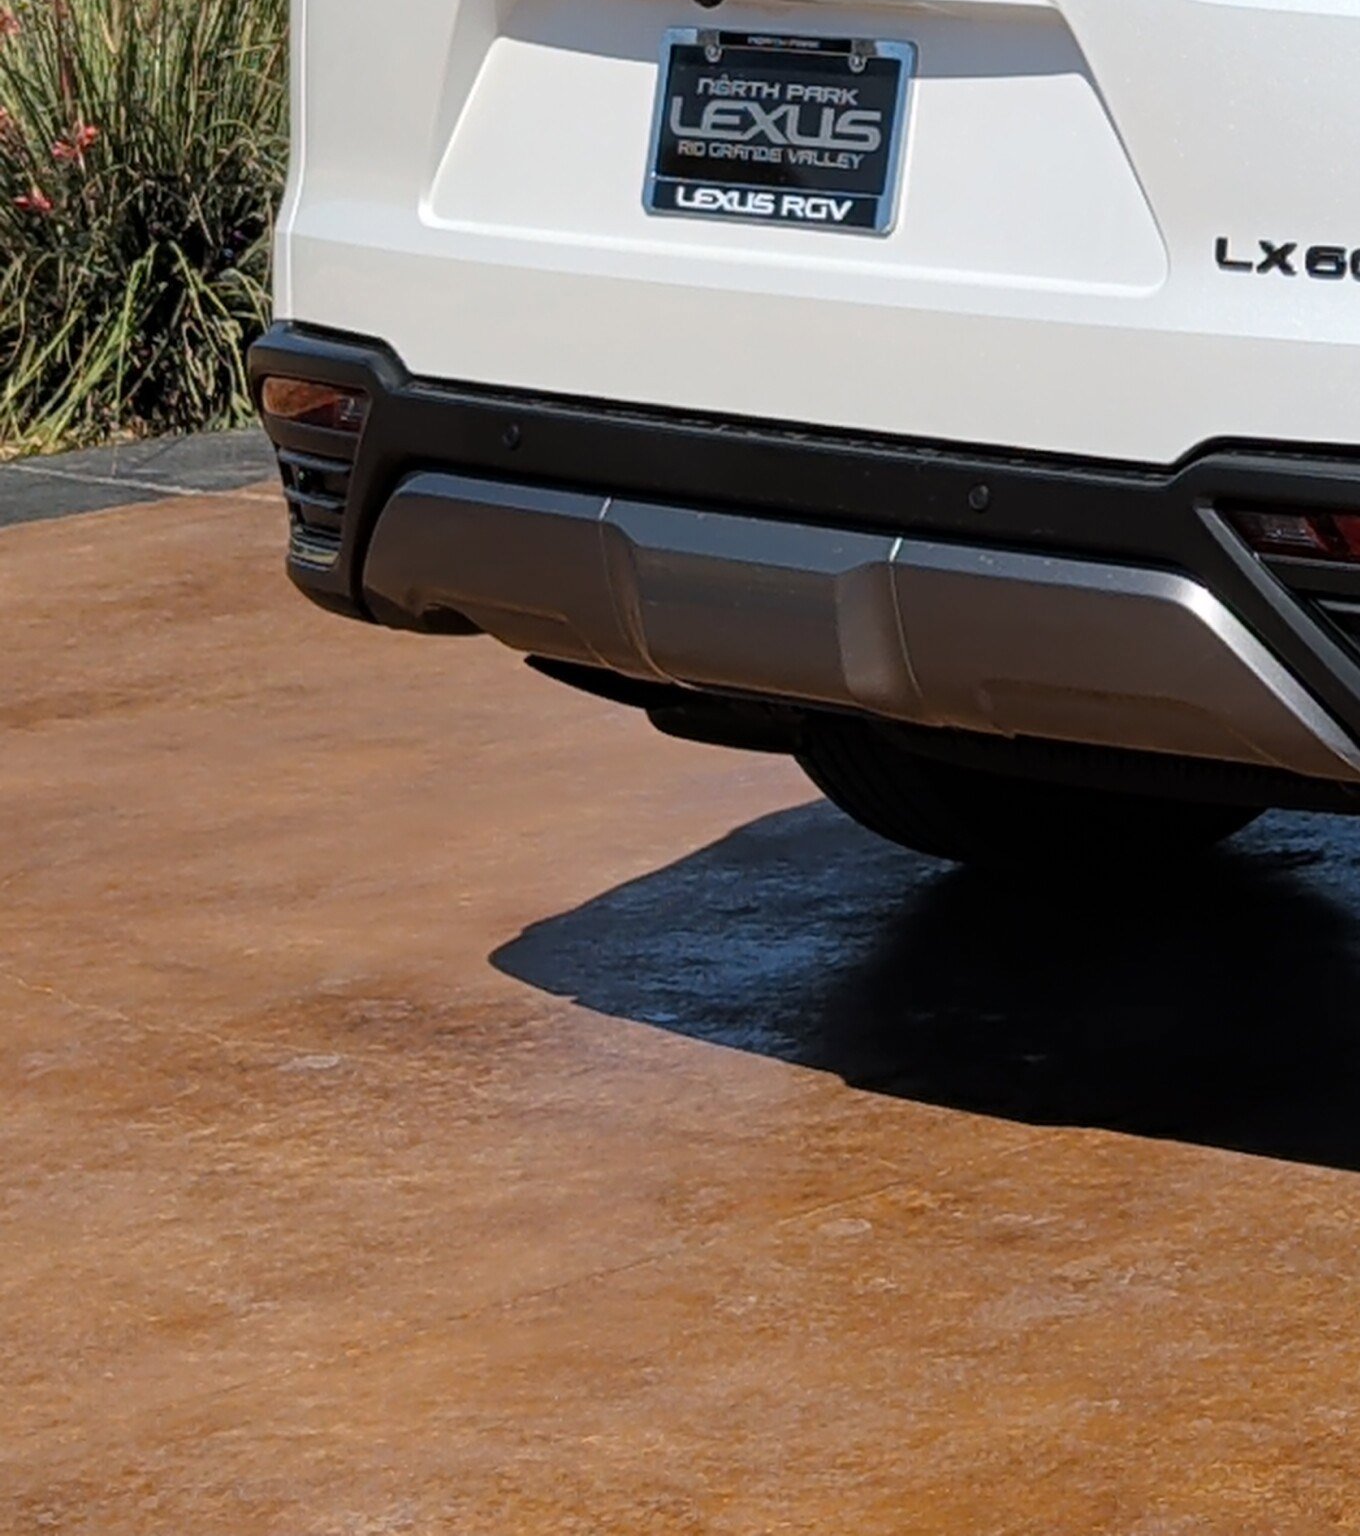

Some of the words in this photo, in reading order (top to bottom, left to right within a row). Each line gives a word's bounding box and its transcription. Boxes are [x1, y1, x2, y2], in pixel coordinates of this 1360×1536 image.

[697, 76, 780, 101] NORTH
[787, 84, 858, 106] PARK
[669, 96, 882, 152] LEXUS
[677, 141, 706, 157] RIO
[708, 143, 782, 164] GRANDE
[787, 149, 864, 170] VALLEY
[675, 186, 775, 215] LEXUS
[781, 197, 853, 221] RGV
